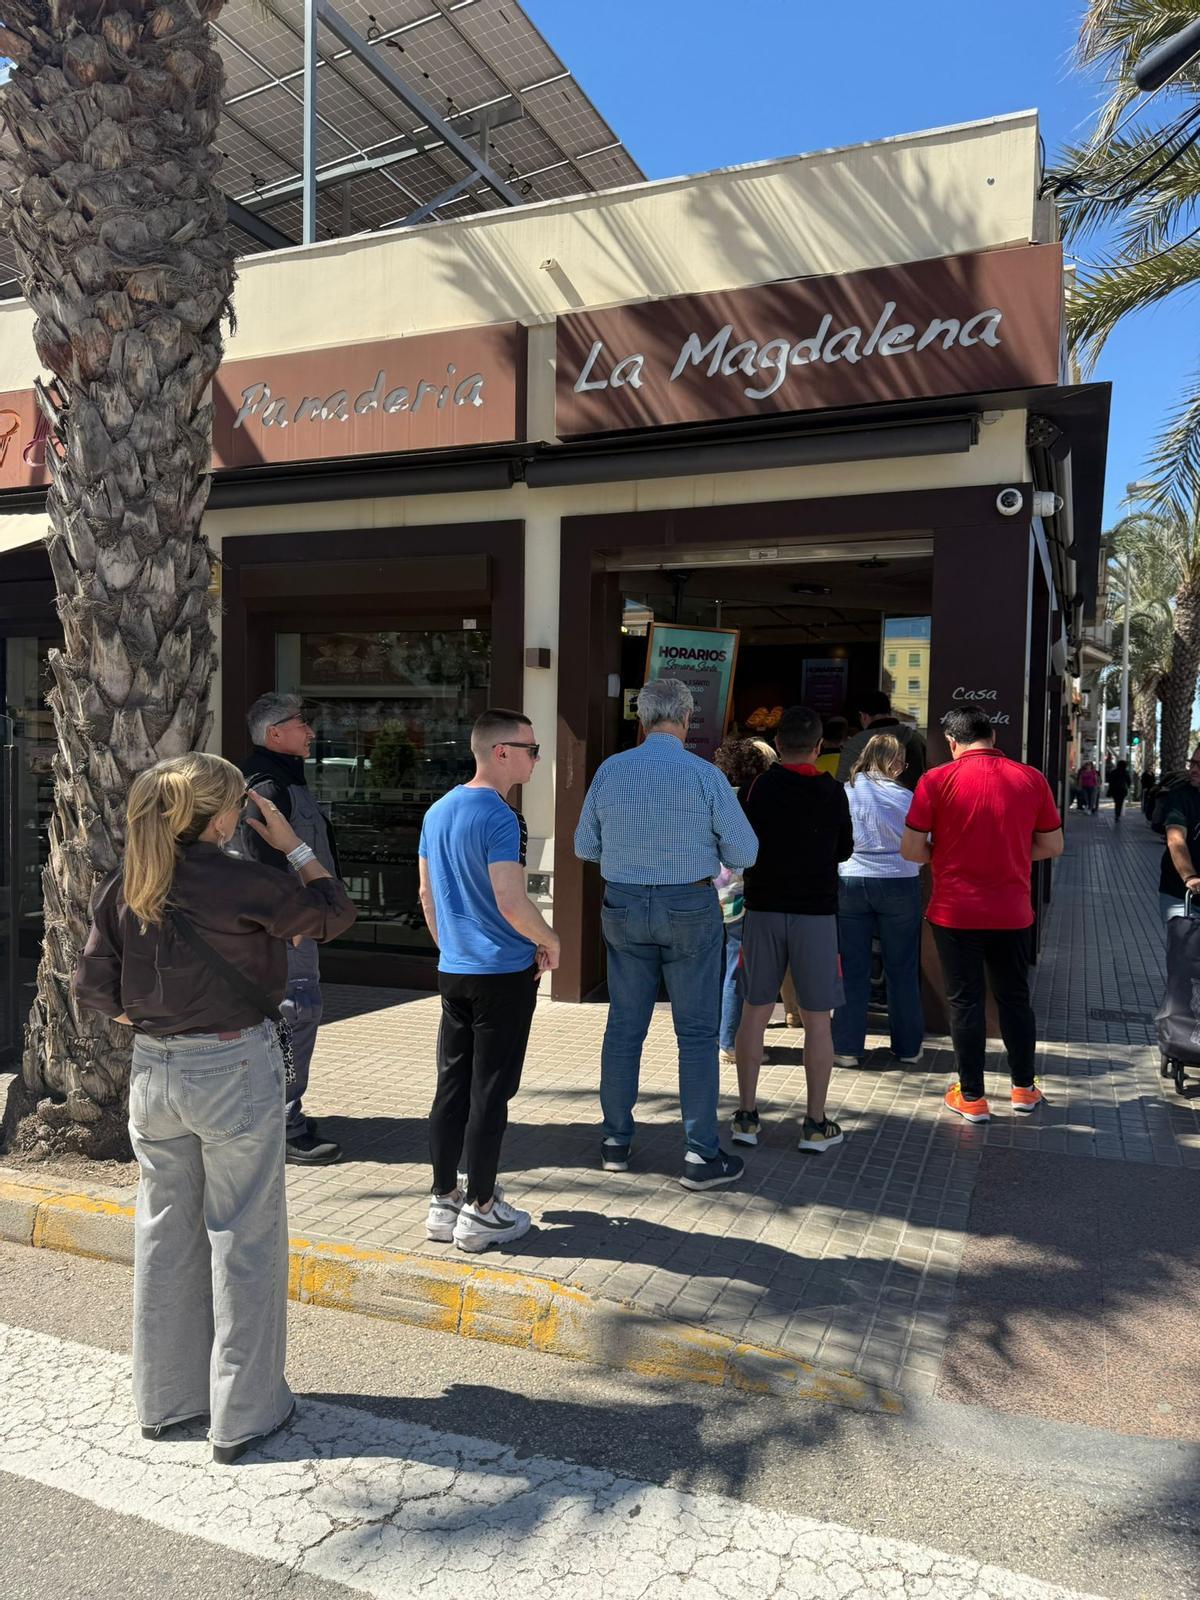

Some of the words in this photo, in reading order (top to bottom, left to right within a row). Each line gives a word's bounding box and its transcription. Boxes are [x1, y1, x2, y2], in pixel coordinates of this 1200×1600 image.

[573, 340, 646, 394] La
[670, 300, 1003, 400] Magdalena
[659, 646, 727, 662] HORARIOS
[951, 686, 998, 701] Casa
